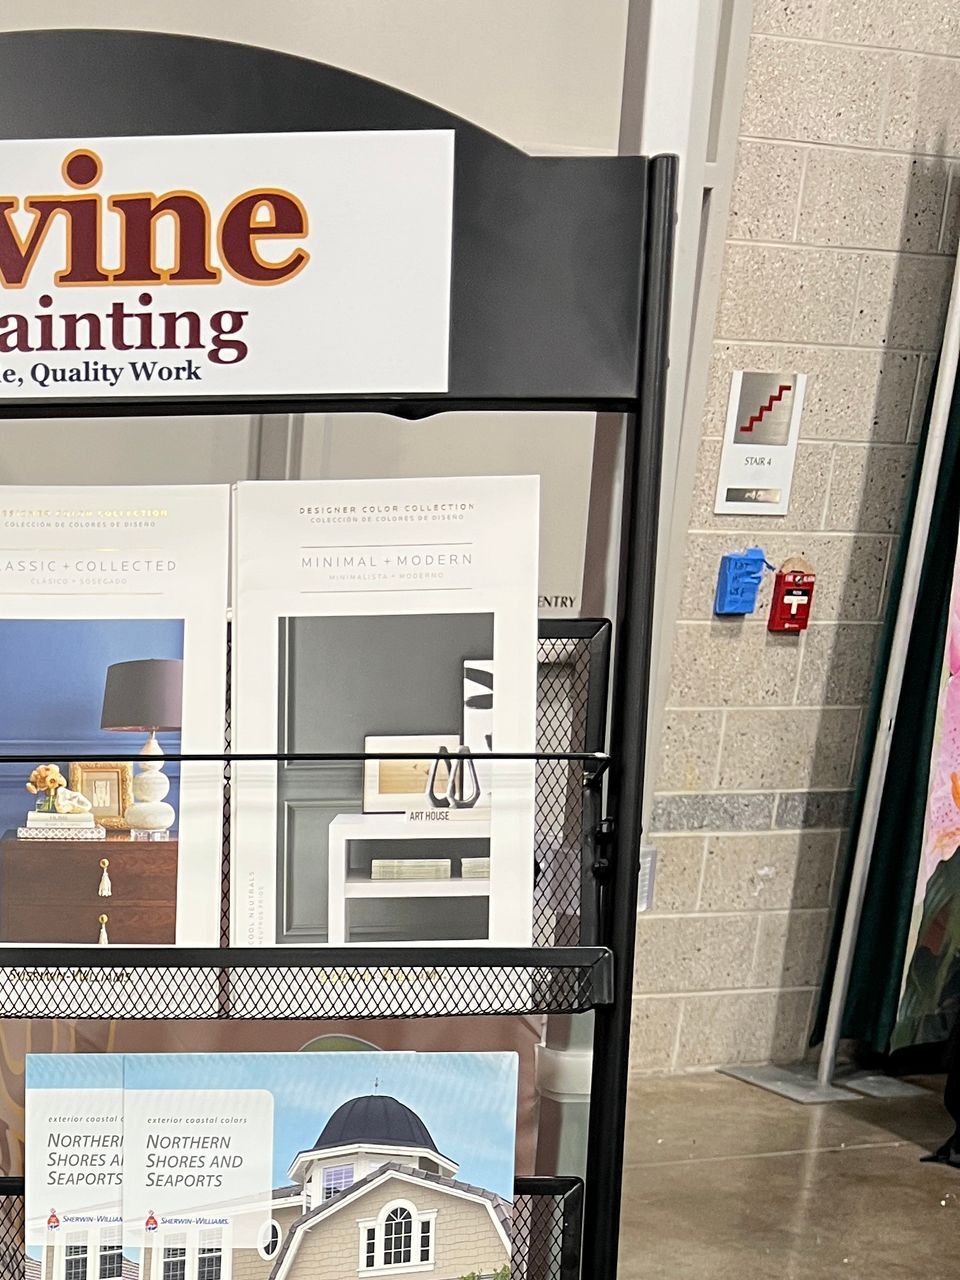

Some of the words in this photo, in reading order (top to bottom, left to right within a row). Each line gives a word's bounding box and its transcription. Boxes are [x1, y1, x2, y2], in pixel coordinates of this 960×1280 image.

[30, 360, 124, 386] Quality
[130, 359, 203, 383] Work
[767, 458, 772, 466] 4
[299, 506, 356, 515] DESIGNER
[362, 505, 398, 514] COLOR
[405, 503, 475, 512] COLLECTION
[75, 560, 177, 572] COLLECTED
[301, 556, 377, 568] MINIMAL
[397, 554, 472, 566] MODERN
[410, 811, 424, 821] ART
[425, 811, 449, 821] HOUSE
[48, 1115, 83, 1123] exterior
[86, 1115, 117, 1123] coastal
[147, 1116, 182, 1124] exterior
[186, 1116, 217, 1124] coastal
[220, 1116, 248, 1124] colors
[146, 1133, 231, 1151] NORTHERN
[47, 1152, 107, 1169] SHORES
[145, 1153, 206, 1169] SHORES
[209, 1153, 243, 1169] AND
[47, 1171, 123, 1187] SEAPORTS
[145, 1172, 223, 1188] SEAPORTS
